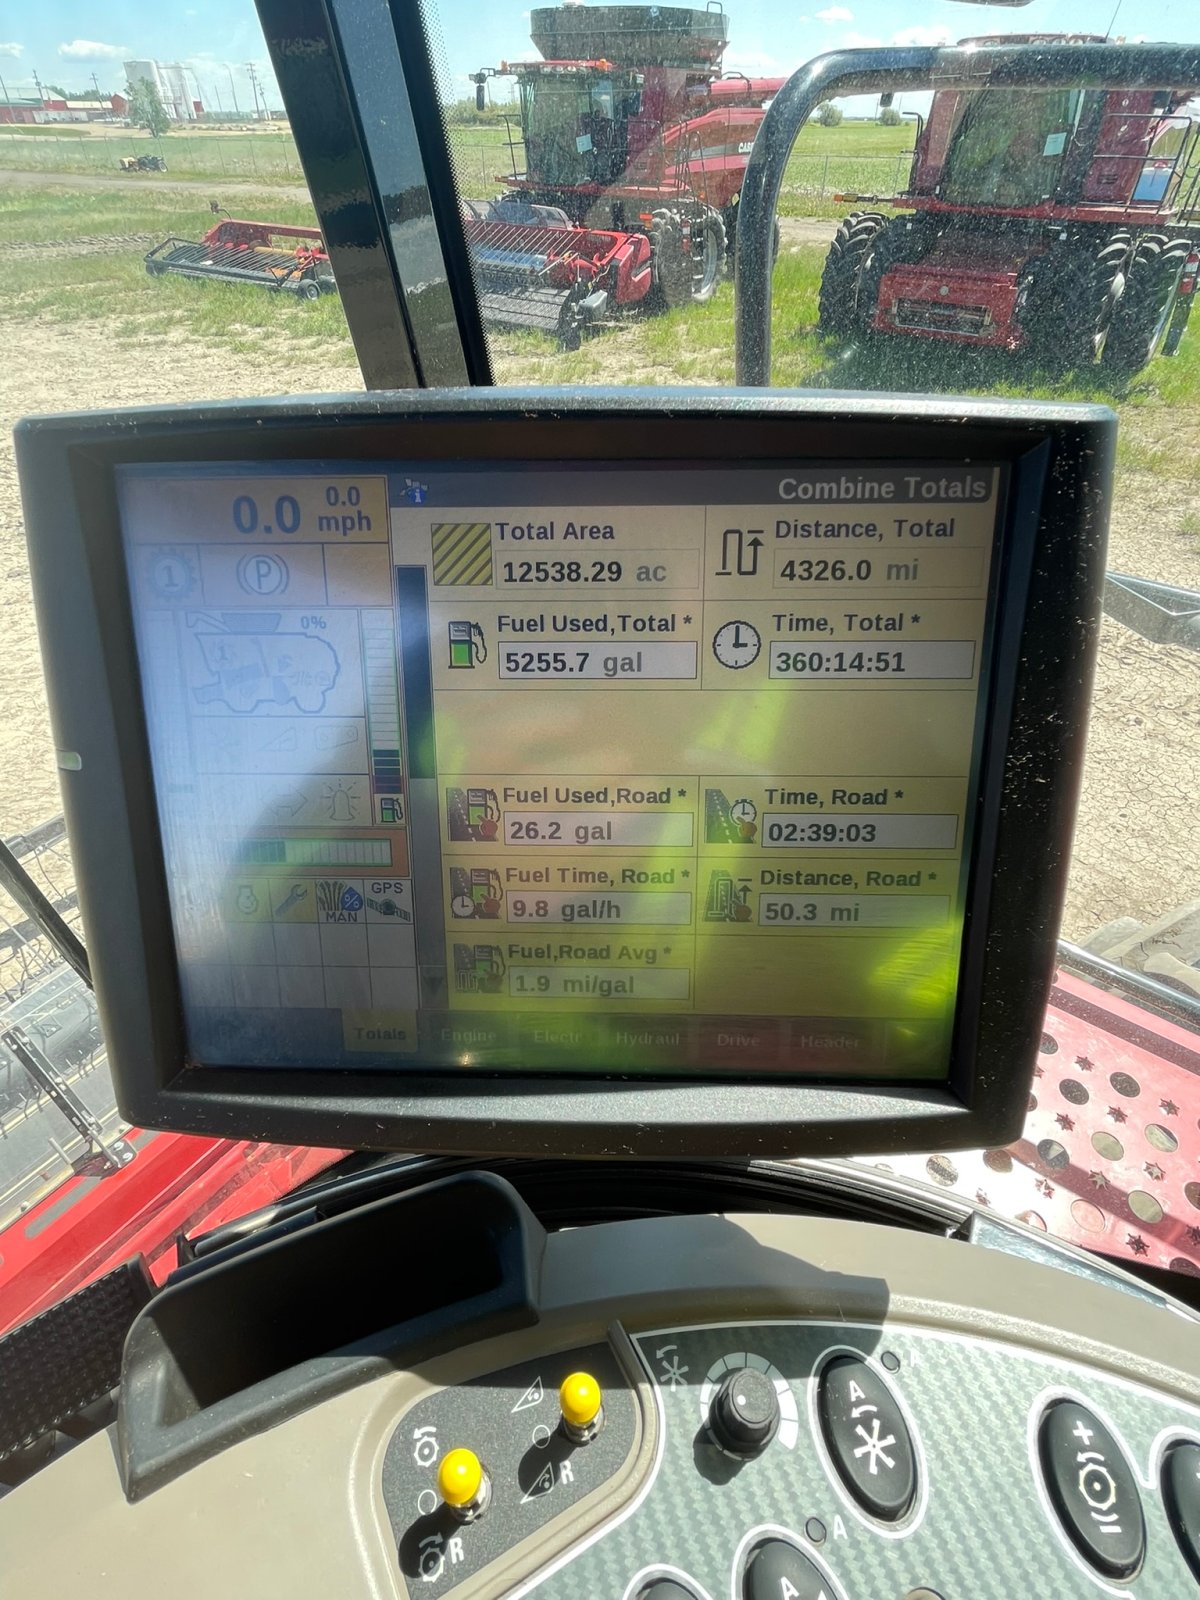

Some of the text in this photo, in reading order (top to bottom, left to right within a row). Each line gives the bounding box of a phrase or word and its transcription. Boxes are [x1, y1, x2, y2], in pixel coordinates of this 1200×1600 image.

[326, 486, 360, 506] 0.0
[778, 475, 986, 499] Combine Totals
[232, 495, 300, 534] 0.0
[318, 510, 372, 536] mph
[495, 521, 615, 540] Total Area
[775, 518, 955, 542] Distance, Total
[503, 561, 667, 583] 12538.29 ac
[780, 558, 918, 581] 4326.0 mi
[301, 616, 326, 629] 0%
[497, 615, 544, 632] Fuel
[772, 614, 834, 635] Time,
[844, 613, 903, 631] Total
[506, 652, 642, 676] 5255.7 gal
[776, 652, 905, 672] 360:14:51
[503, 787, 548, 804] Fuel
[765, 789, 824, 808] Time,
[832, 789, 888, 805] Road
[510, 821, 612, 844] 26.2 gal
[768, 823, 876, 842] 02:39:03
[506, 867, 550, 883] Fuel
[557, 868, 614, 886] Time,
[622, 869, 676, 884] Road
[761, 870, 858, 889] Distance,
[866, 871, 921, 886] Road
[372, 882, 404, 894] GPS
[326, 912, 358, 922] MAN
[513, 900, 620, 921] 9.8 gal/h
[766, 903, 859, 921] 50.3 mi
[618, 945, 657, 964] Avg
[516, 976, 634, 997] 1.9 mi/gal
[356, 1028, 406, 1040] Totals
[441, 1029, 496, 1044] Engine
[616, 1031, 680, 1047] Hydraul
[717, 1034, 760, 1046] Drive
[801, 1035, 859, 1049] Header
[850, 1380, 866, 1402] A
[560, 1460, 574, 1484] R
[833, 1514, 848, 1540] A
[450, 1537, 464, 1564] R
